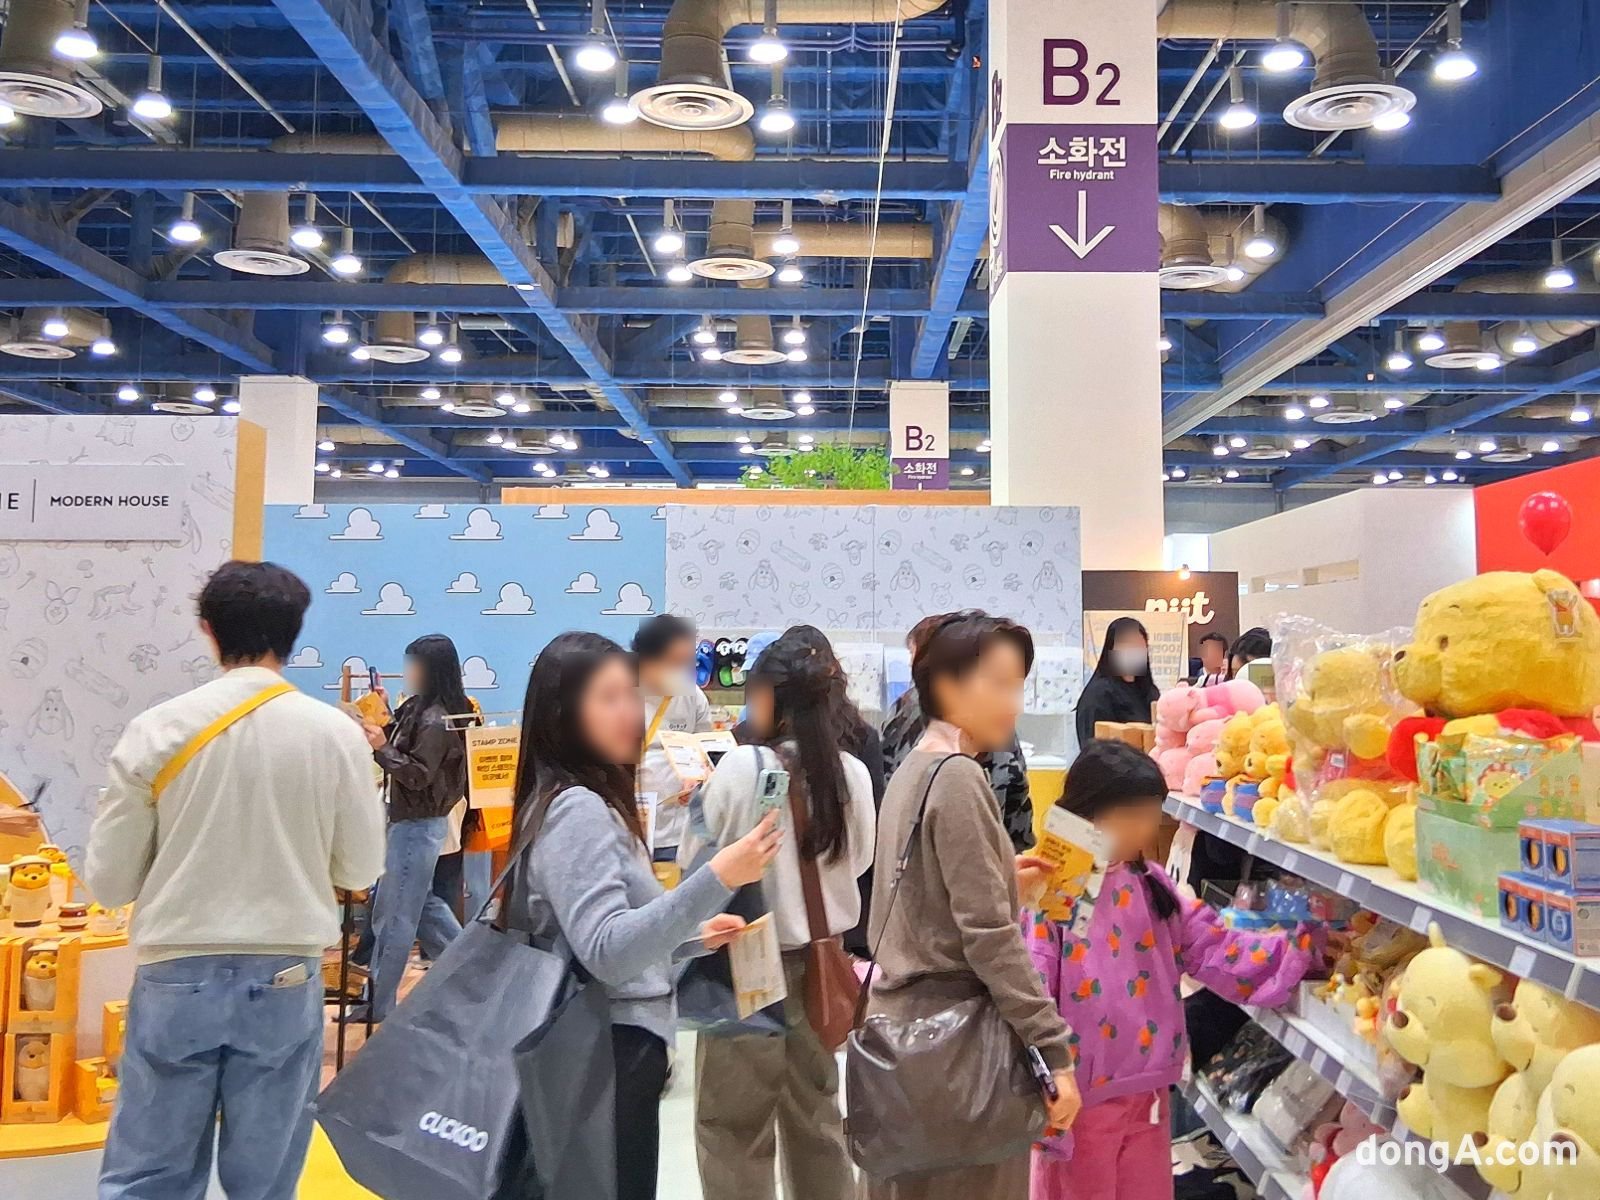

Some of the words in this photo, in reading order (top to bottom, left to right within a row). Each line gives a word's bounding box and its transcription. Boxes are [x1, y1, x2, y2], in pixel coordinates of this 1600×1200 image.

[1043, 38, 1121, 106] B2
[1037, 136, 1127, 168] 소화전
[1049, 168, 1072, 180] Fire
[1073, 168, 1115, 182] hydrant
[905, 425, 936, 452] B2
[903, 462, 938, 475] 소화전
[50, 495, 113, 507] MODERN
[118, 495, 170, 507] HOUSE
